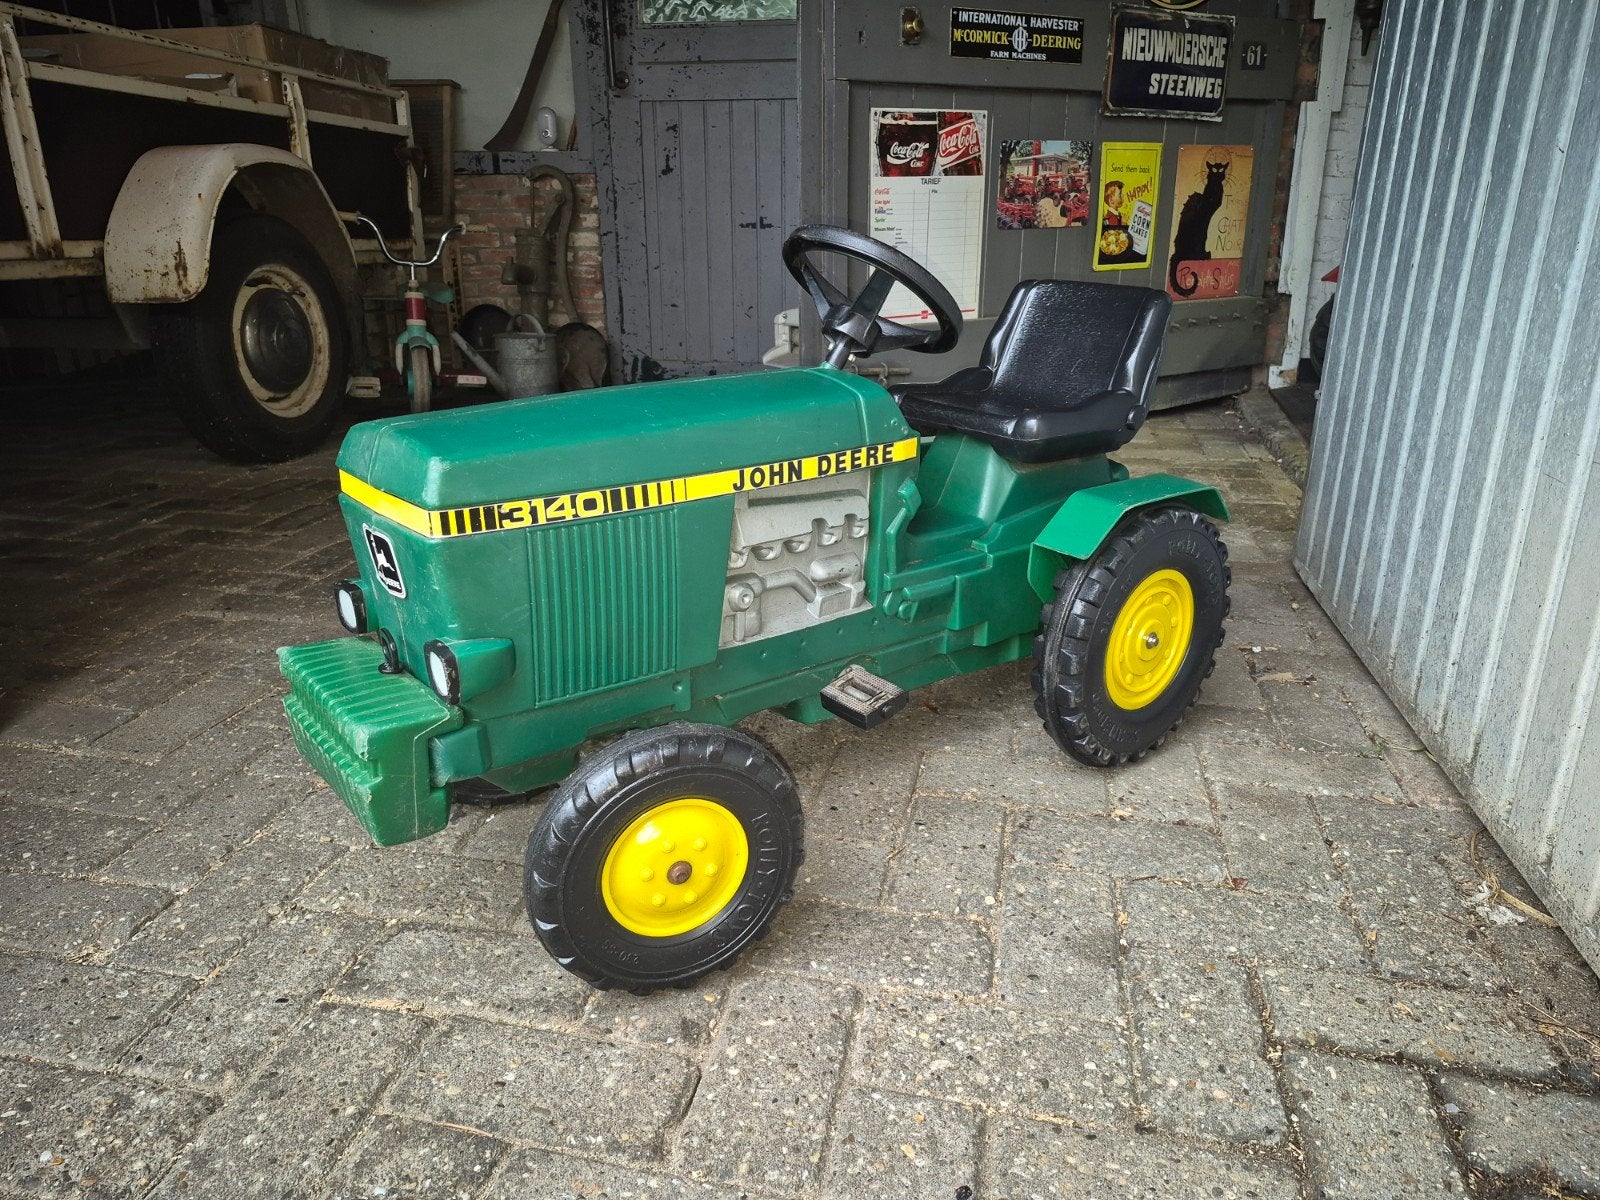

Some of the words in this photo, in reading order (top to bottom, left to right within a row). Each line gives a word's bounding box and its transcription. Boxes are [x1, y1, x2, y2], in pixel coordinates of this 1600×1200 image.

[958, 11, 1027, 27] INTERNATIONAL
[1030, 17, 1079, 31] HARVESTER
[1032, 34, 1082, 50] DEERING
[1122, 27, 1228, 68] NIEUWMOERSCHE
[990, 50, 1010, 59] FARM
[1011, 51, 1047, 60] MACHINES
[1246, 45, 1262, 66] 61
[1148, 73, 1222, 99] STEENWEG
[1111, 163, 1124, 173] Send
[1126, 164, 1138, 173] them
[1139, 164, 1151, 174] back
[921, 178, 941, 186] TARIEF
[1132, 214, 1152, 230] CORN
[1130, 225, 1148, 239] FLAKES
[732, 458, 802, 492] JOHN
[817, 442, 896, 476] DEERE
[501, 491, 604, 529] 3140
